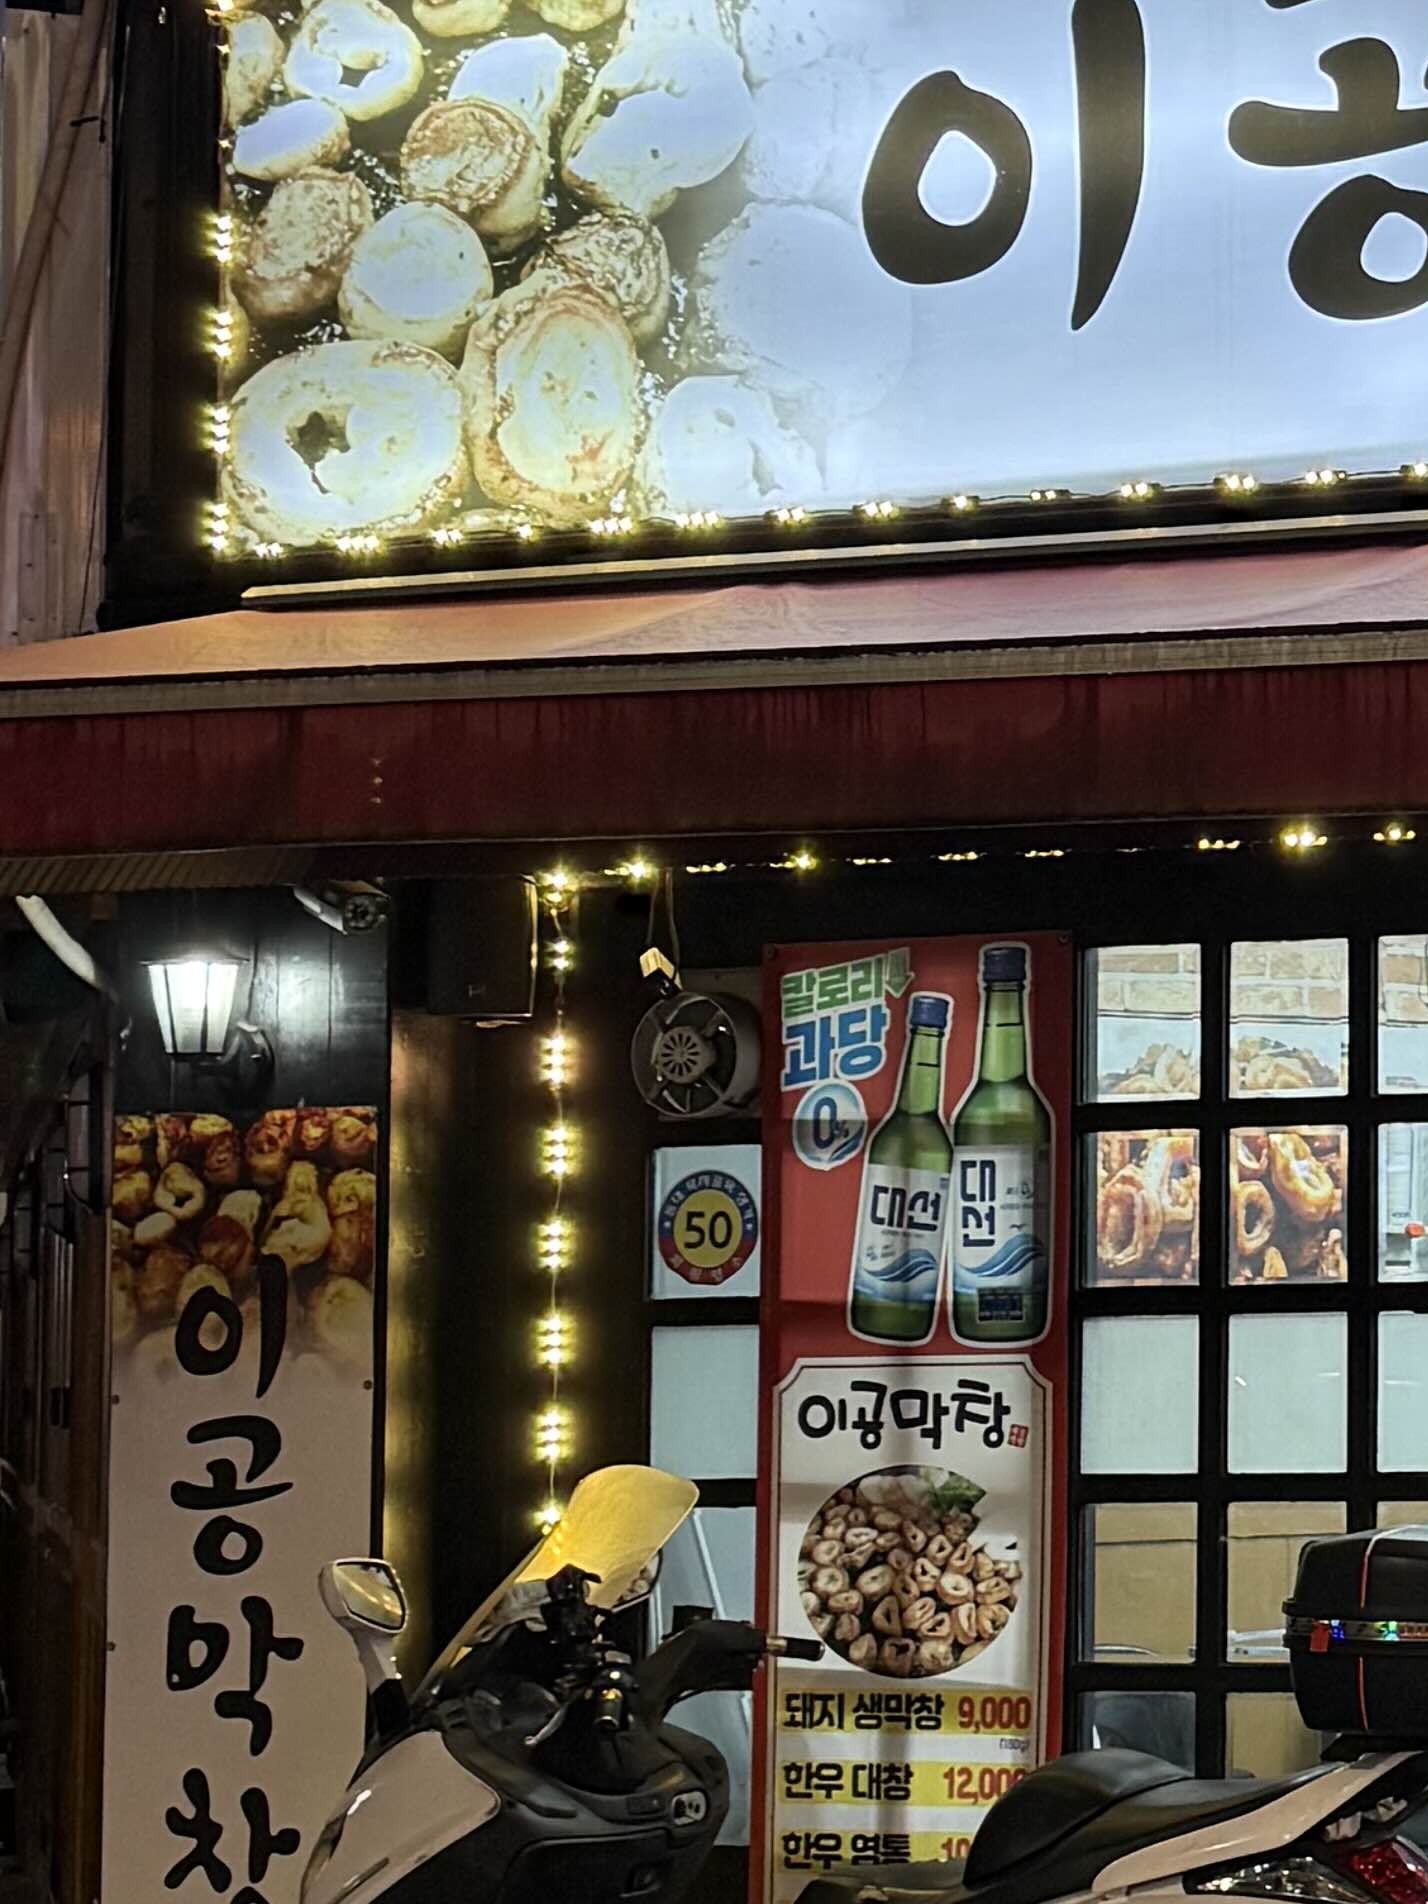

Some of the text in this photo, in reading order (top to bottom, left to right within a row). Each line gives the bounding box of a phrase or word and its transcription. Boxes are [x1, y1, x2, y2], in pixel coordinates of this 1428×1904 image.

[783, 957, 884, 1019] 칼로리
[784, 1004, 888, 1086] 과당
[870, 1185, 941, 1232] 대선
[960, 1160, 996, 1247] 대선
[684, 1210, 732, 1249] 50
[798, 1379, 1011, 1450] 이공막창
[784, 1693, 1032, 1734] 돼지 생막창 9,000
[783, 1762, 844, 1799] 한우
[852, 1763, 914, 1801] 대창
[782, 1832, 842, 1870] 한우
